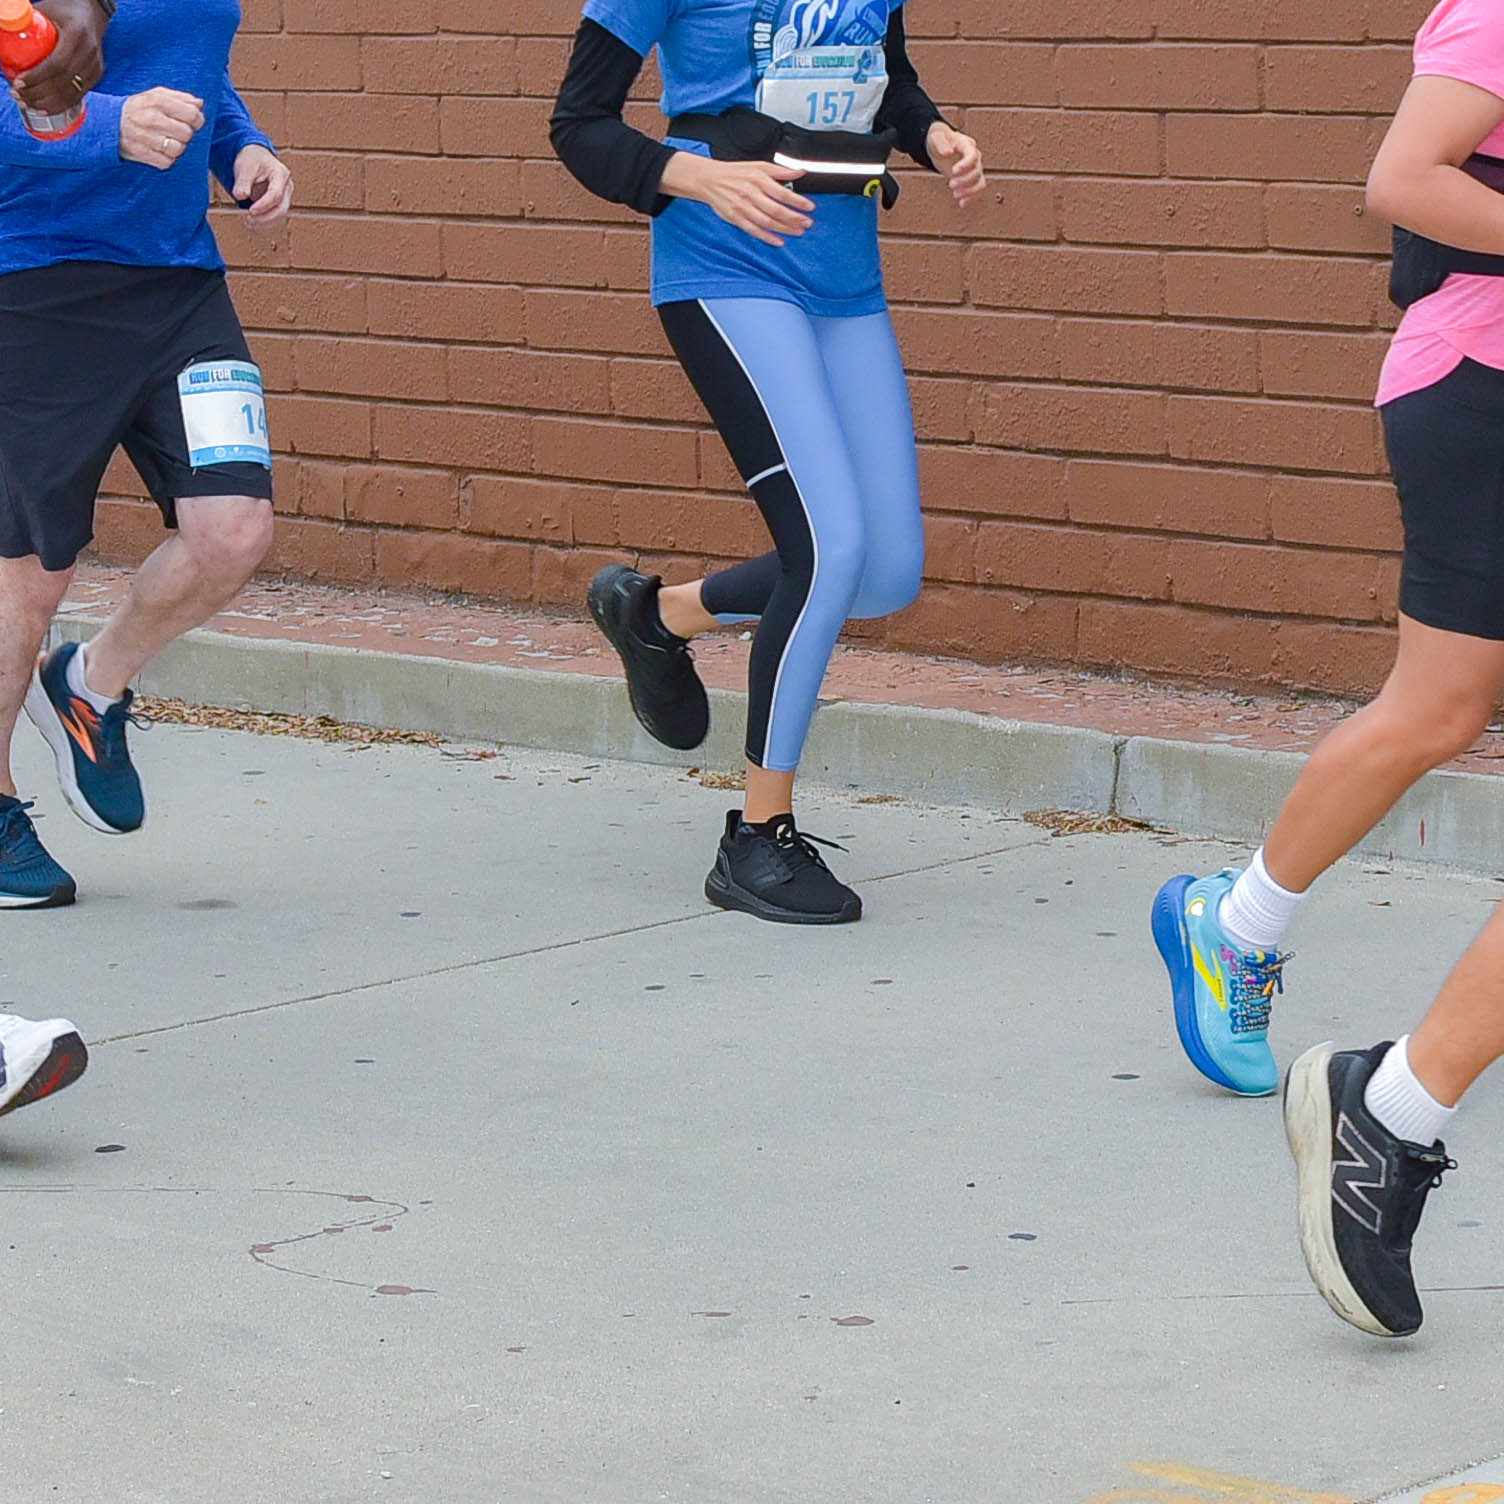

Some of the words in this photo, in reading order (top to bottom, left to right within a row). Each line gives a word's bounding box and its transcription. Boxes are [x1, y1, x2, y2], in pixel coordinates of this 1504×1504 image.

[753, 21, 773, 50] FOR
[806, 90, 856, 124] 157
[211, 368, 231, 382] FOR
